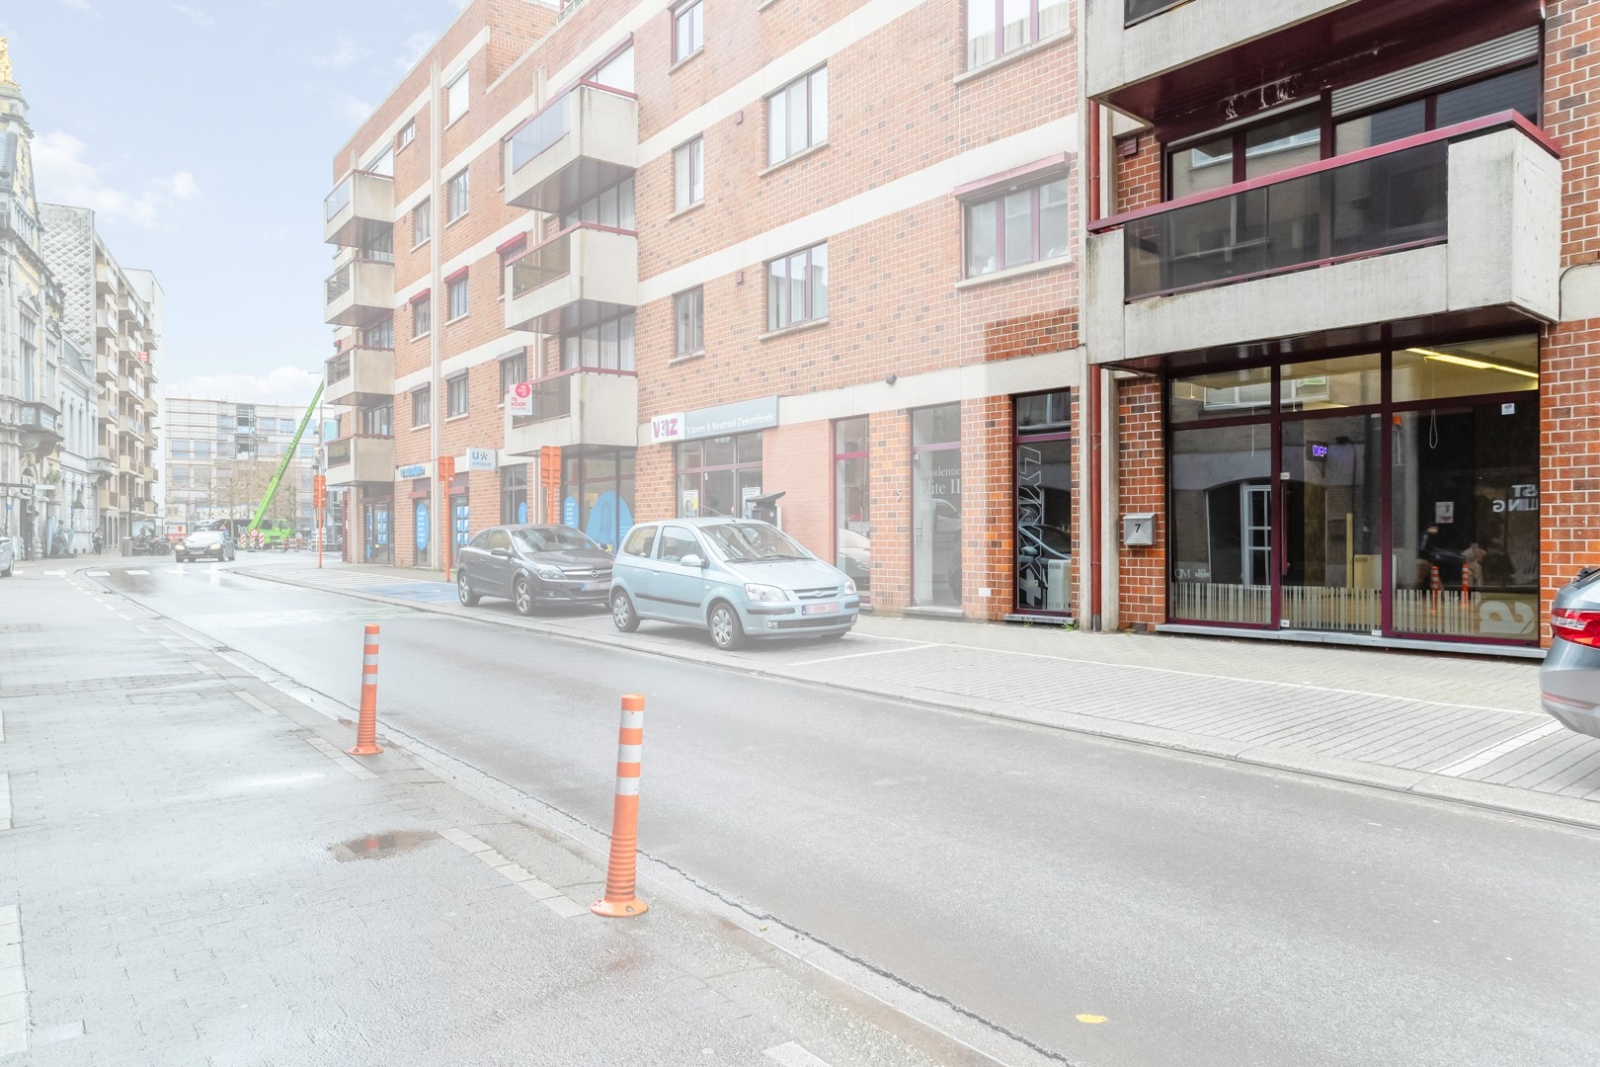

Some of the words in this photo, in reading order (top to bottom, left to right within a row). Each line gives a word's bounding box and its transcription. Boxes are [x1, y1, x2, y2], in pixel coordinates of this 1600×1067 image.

[712, 418, 737, 431] Neutraal
[737, 413, 774, 427] Ziekenfonds
[1134, 523, 1141, 534] 7
